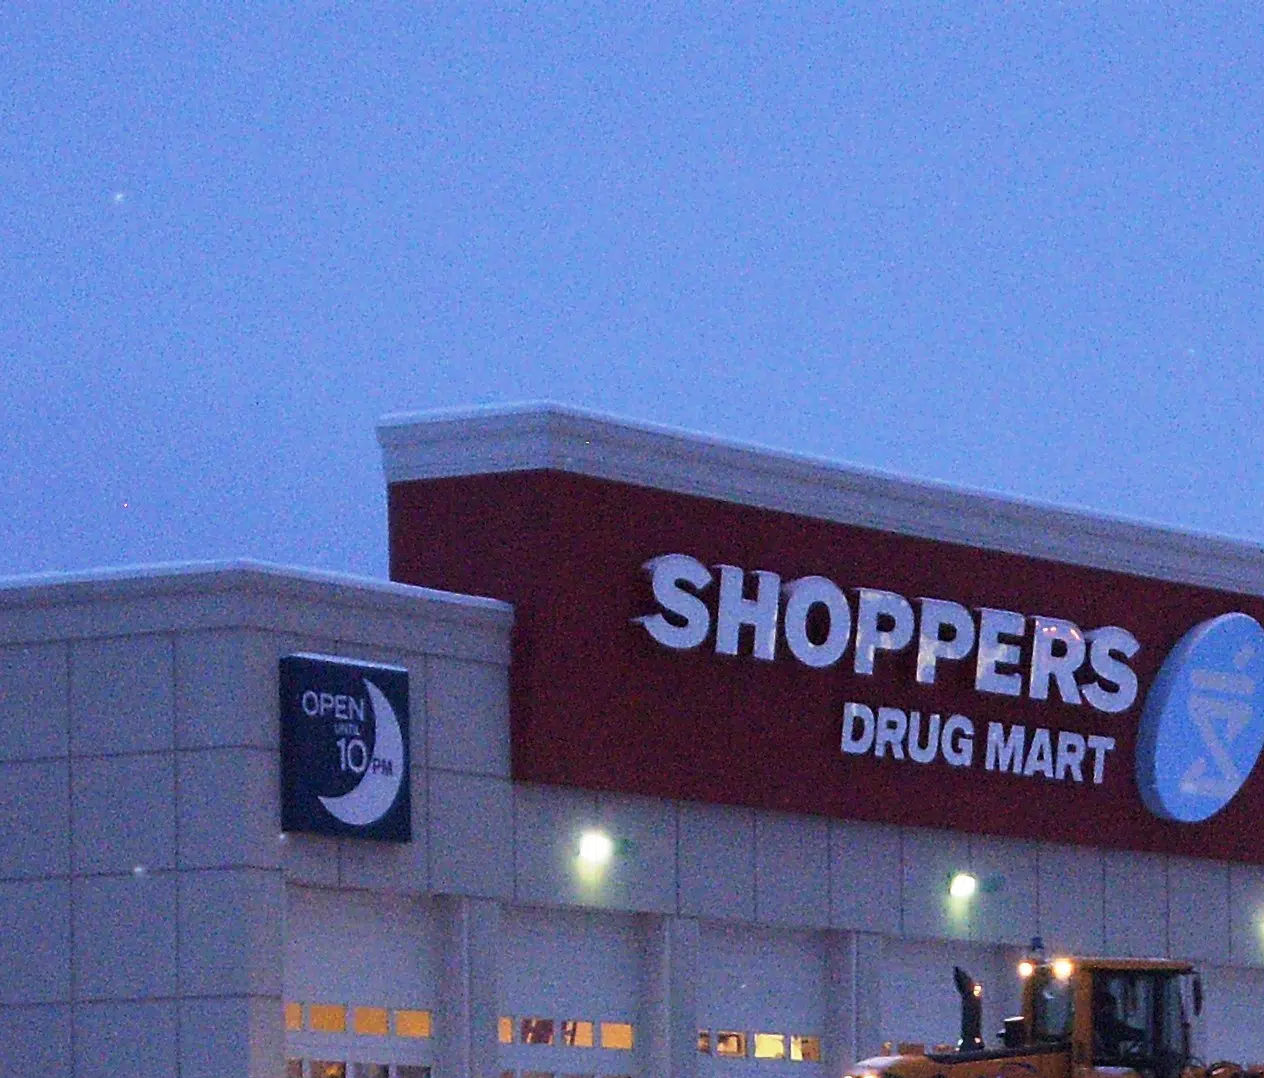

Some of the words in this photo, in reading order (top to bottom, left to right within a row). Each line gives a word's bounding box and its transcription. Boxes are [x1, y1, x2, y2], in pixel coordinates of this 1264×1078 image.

[636, 552, 1141, 713] SHOPPERS
[302, 690, 366, 722] OPEN
[336, 738, 368, 774] 10
[371, 757, 394, 777] PM
[840, 701, 975, 768] DRUG
[984, 722, 1117, 785] MART
